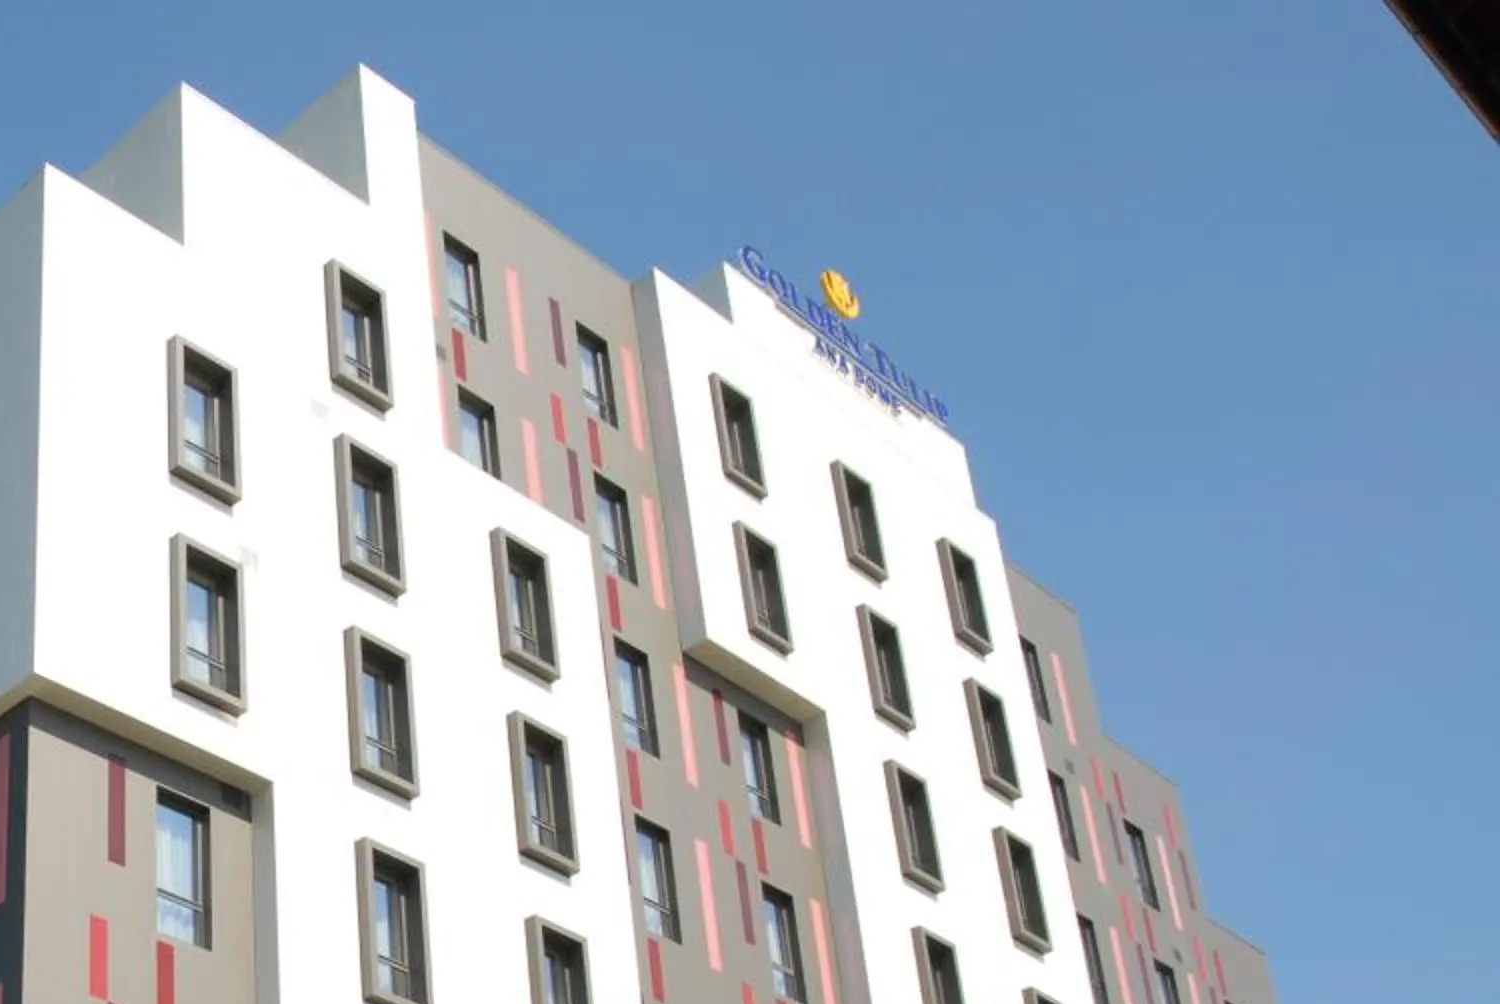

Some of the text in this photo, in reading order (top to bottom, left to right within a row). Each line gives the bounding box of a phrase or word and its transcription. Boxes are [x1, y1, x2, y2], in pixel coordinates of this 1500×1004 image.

[740, 246, 950, 421] GOLDEN TULIP
[813, 336, 903, 418] ANA DOME
